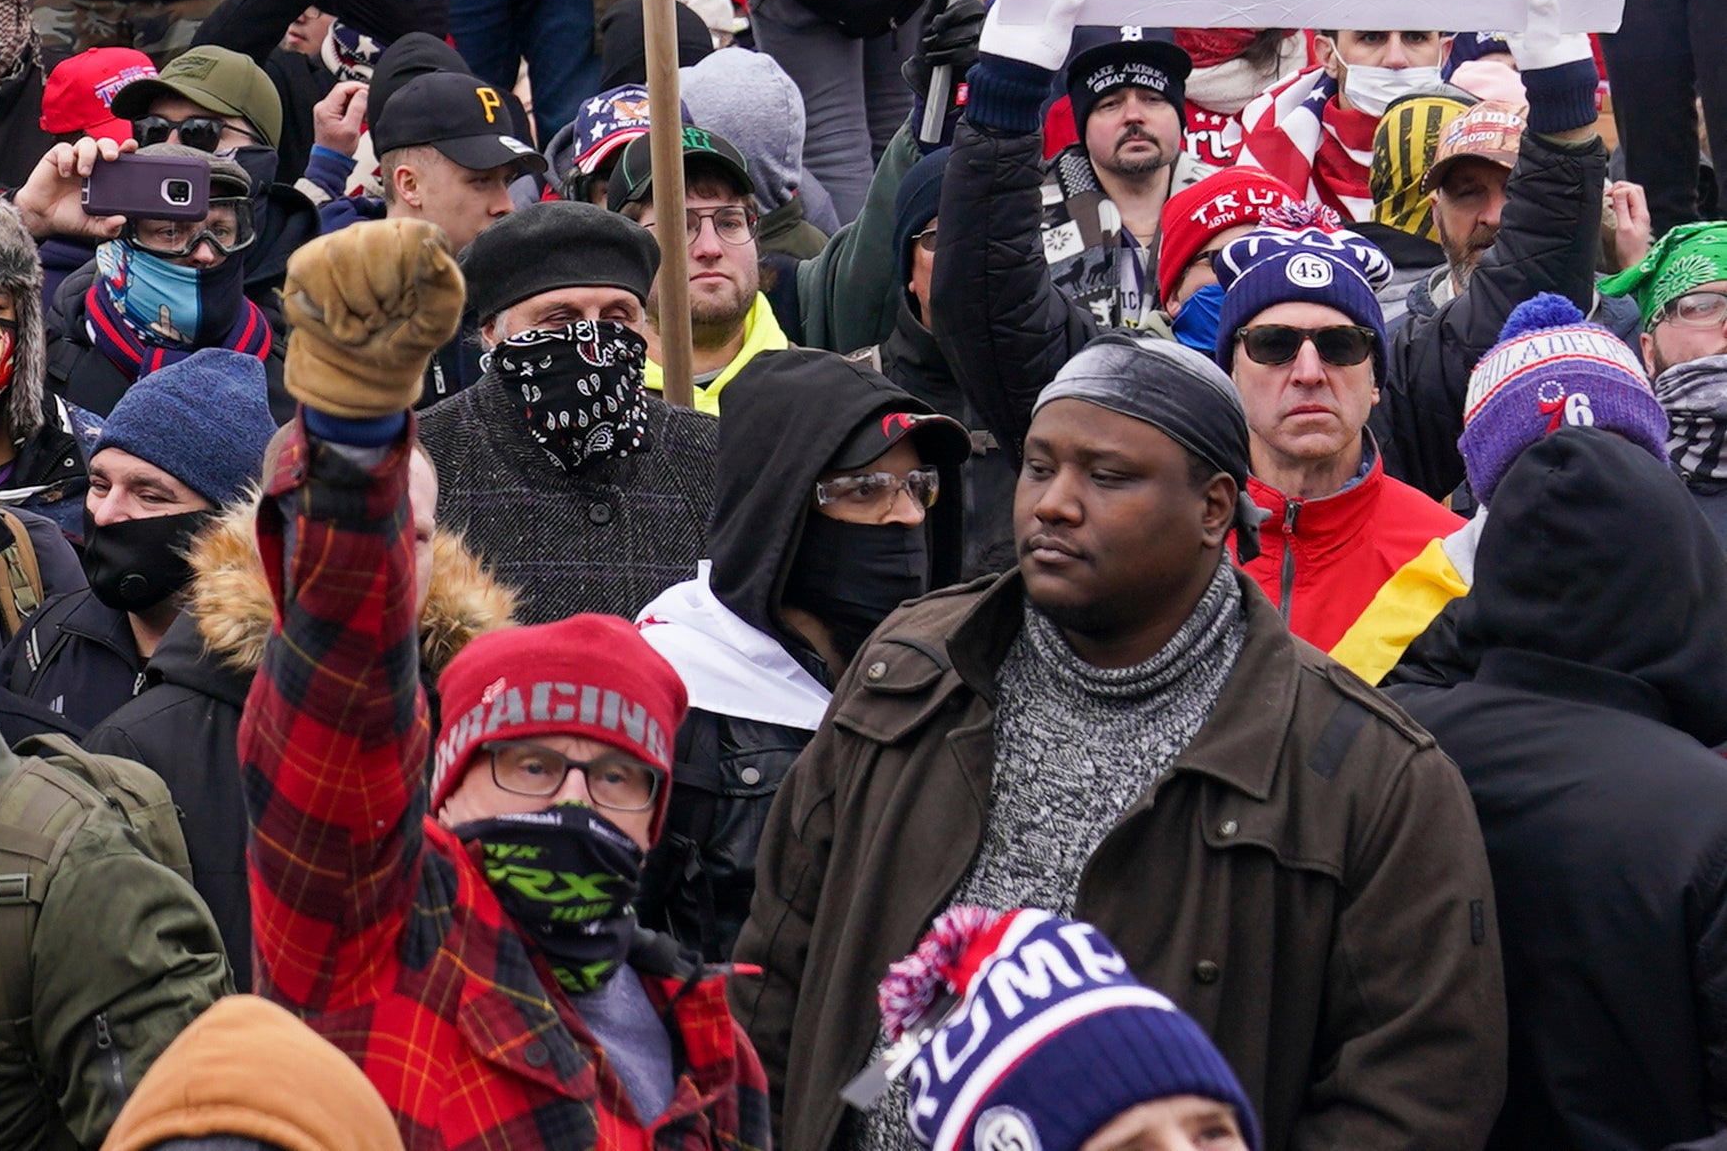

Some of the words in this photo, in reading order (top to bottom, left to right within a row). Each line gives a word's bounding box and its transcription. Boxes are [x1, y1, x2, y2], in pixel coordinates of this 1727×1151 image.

[1086, 65, 1116, 88] MAKE
[1122, 63, 1170, 86] AMERICA
[1093, 74, 1127, 93] GREAT
[1131, 75, 1166, 92] AGAIN
[476, 88, 502, 124] P
[1296, 263, 1323, 279] 45
[1538, 392, 1595, 434] 76
